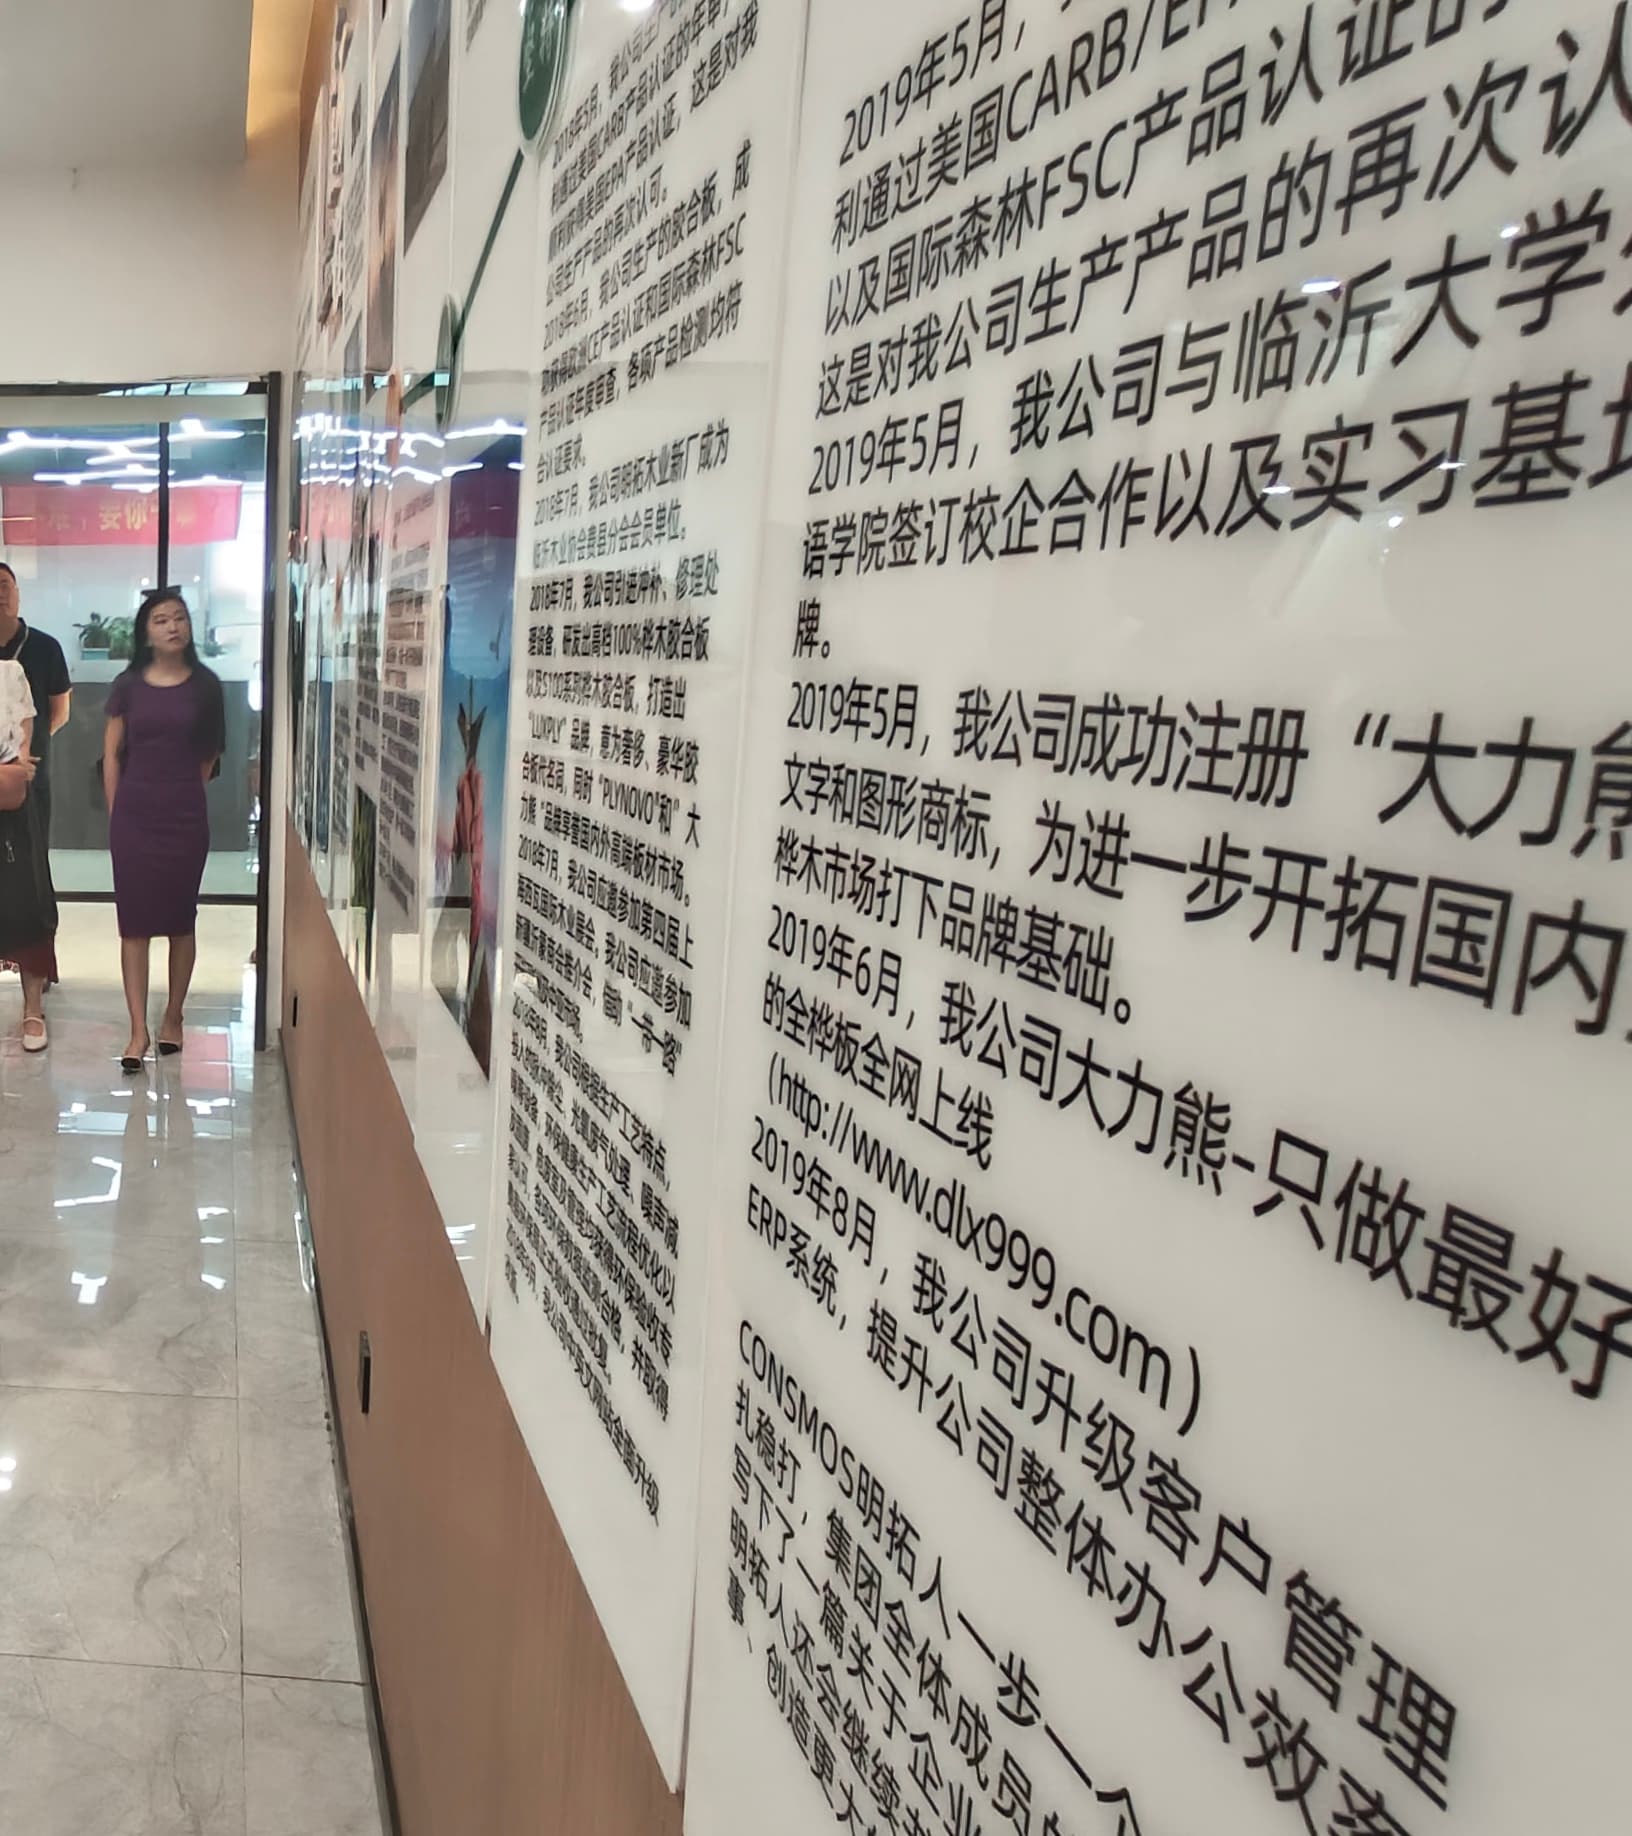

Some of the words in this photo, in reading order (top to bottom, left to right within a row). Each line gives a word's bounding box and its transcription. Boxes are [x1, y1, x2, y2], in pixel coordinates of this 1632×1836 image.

[815, 0, 1632, 420] 这是对我公司生产产品的再次认
[831, 0, 1238, 255] 利通过美国CARB/E
[808, 188, 1632, 495] 2019年5月，我公司与临沂大学
[793, 598, 831, 660] 牌。
[773, 826, 1131, 1025] 桦木市场打下品牌基础。
[762, 970, 995, 1171] 的全桦板全网上线
[751, 1115, 1458, 1812] 2019年8月，我公司升级客户管理
[734, 1378, 1060, 1836] 扎稳打，集团全体成员
